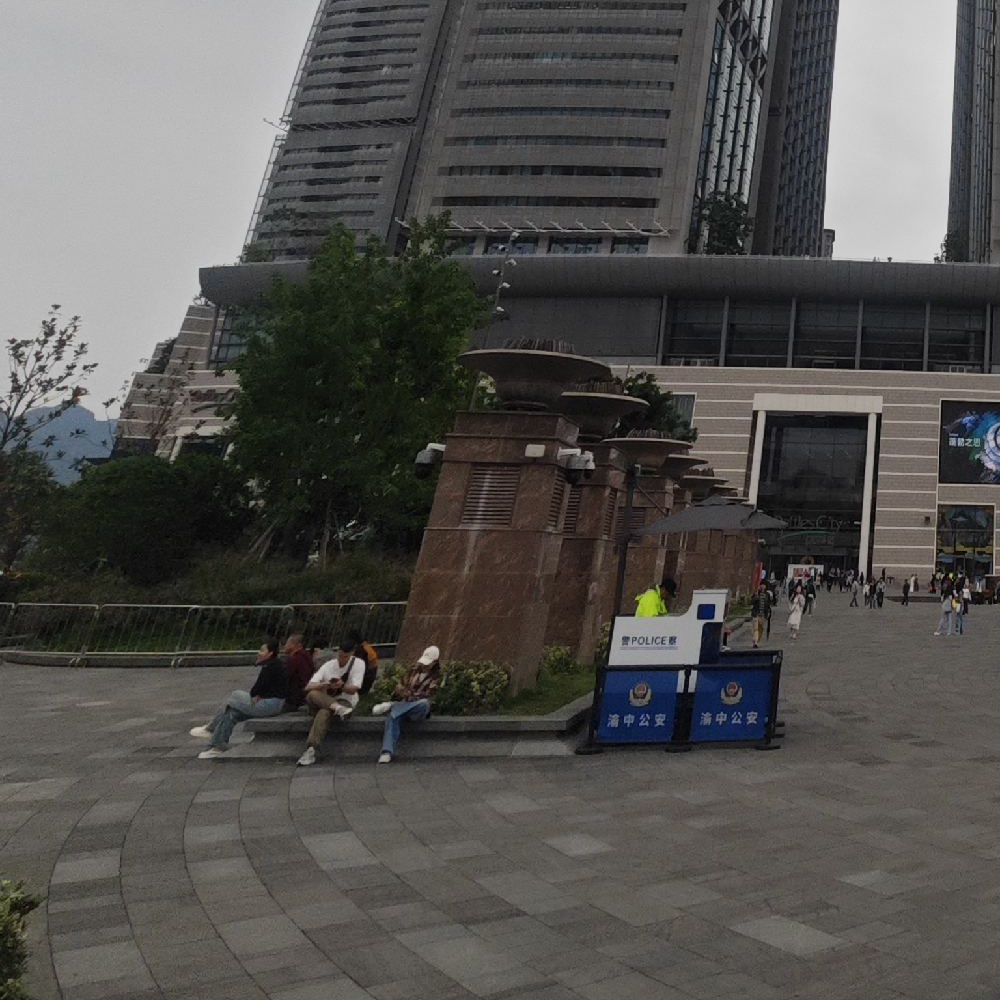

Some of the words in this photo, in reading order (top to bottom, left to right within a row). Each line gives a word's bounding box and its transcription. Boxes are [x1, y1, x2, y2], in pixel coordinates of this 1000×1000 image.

[607, 713, 667, 728] 渝中公安
[700, 711, 759, 726] 渝中公安
